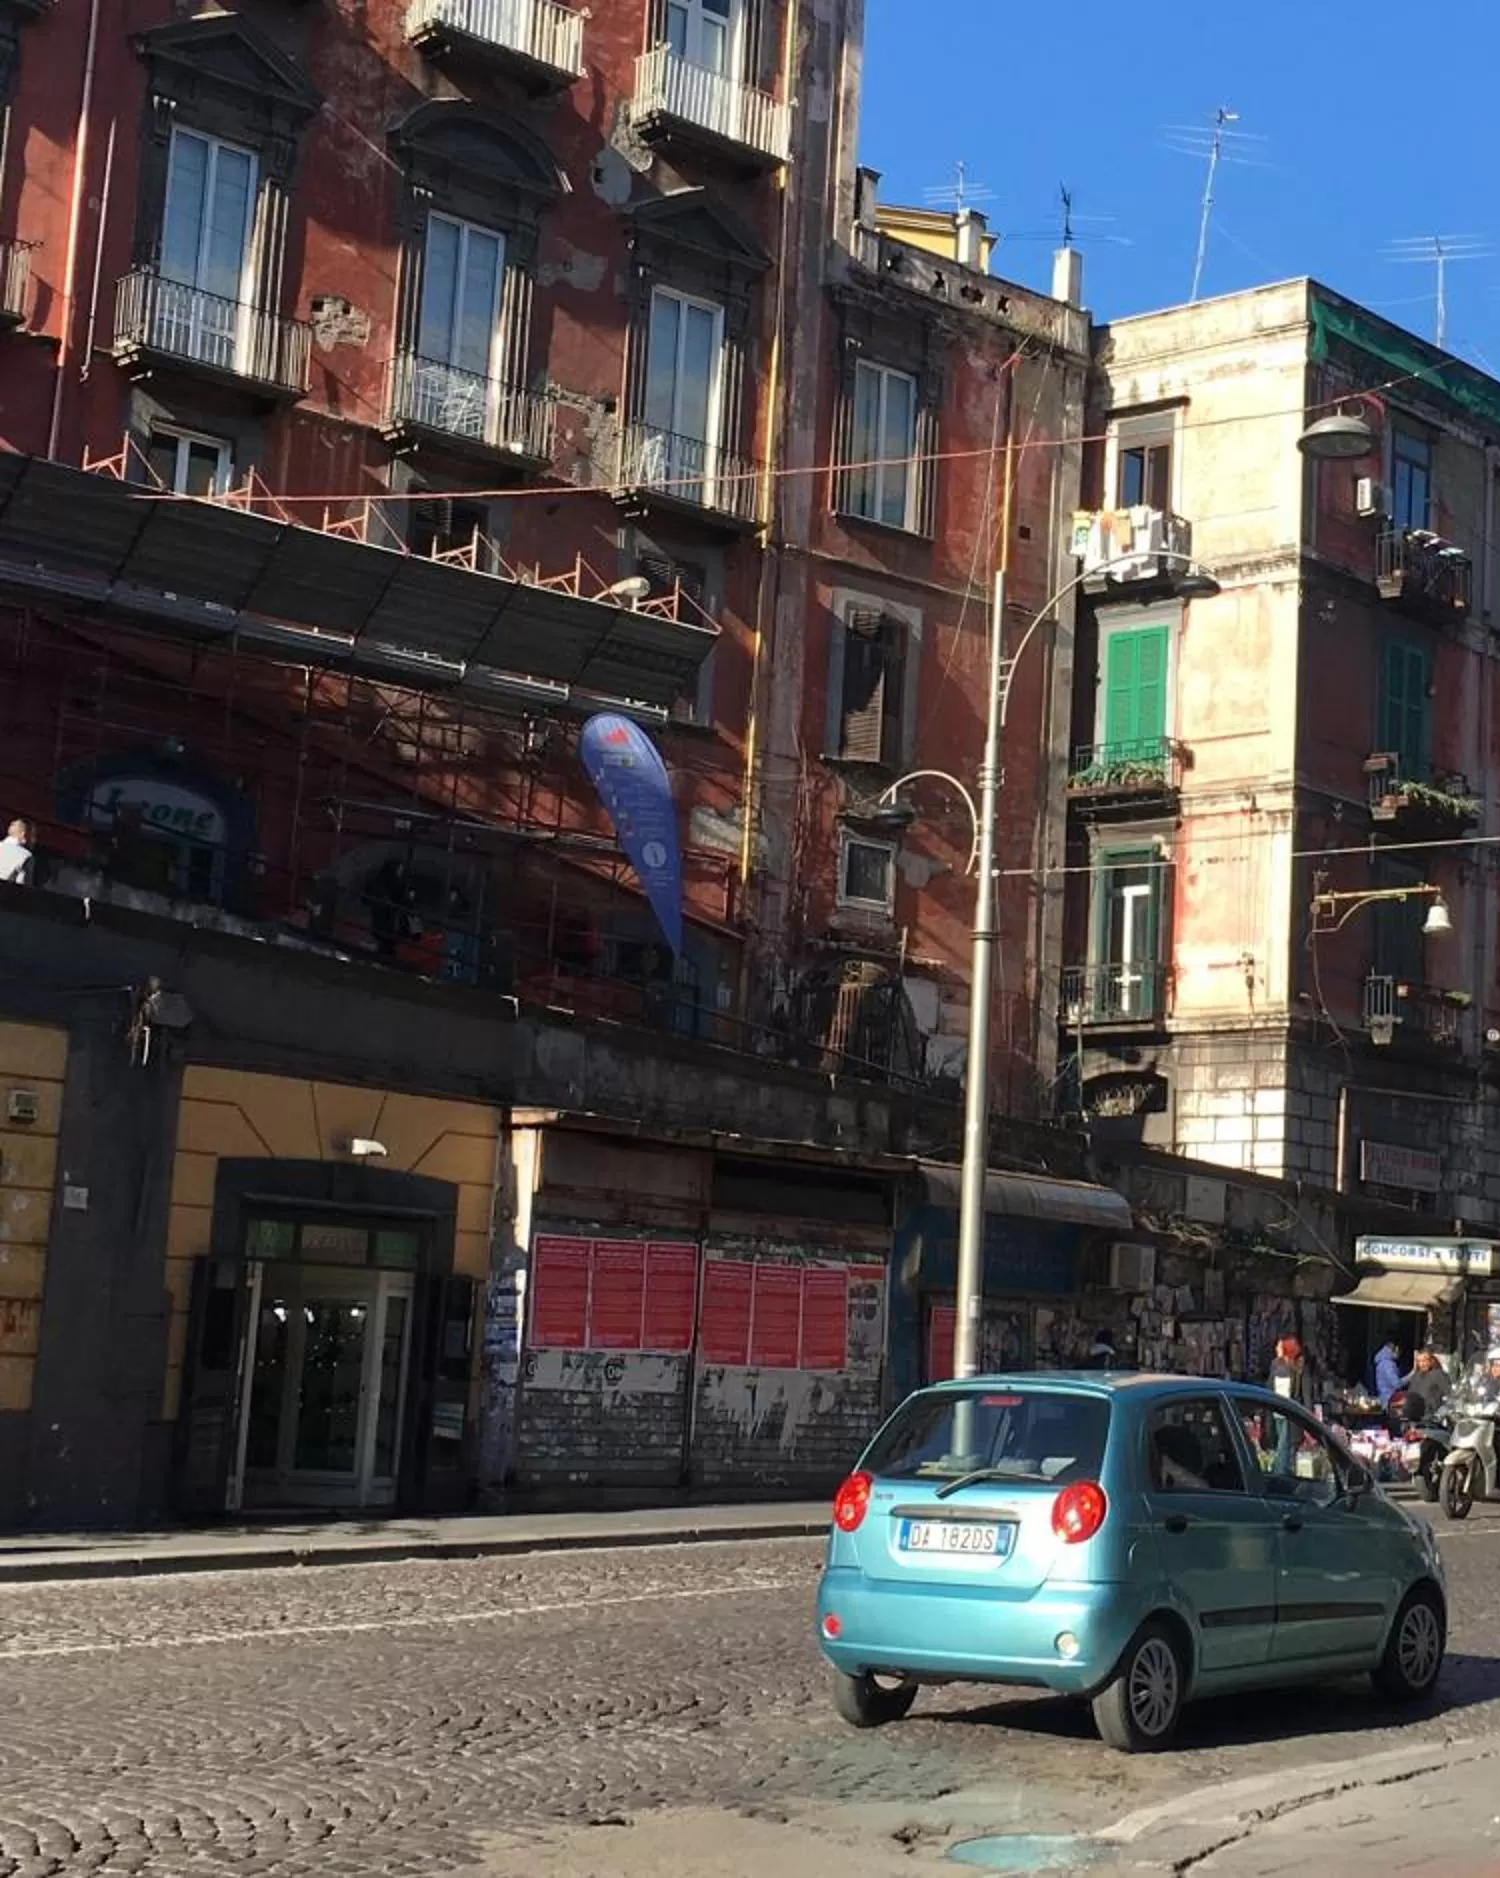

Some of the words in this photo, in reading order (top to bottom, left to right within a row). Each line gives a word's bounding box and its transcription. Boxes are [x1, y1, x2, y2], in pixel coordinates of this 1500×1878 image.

[1363, 1245, 1431, 1258] CONCORSI
[911, 1524, 930, 1547] DA
[941, 1525, 995, 1550] 182DS
